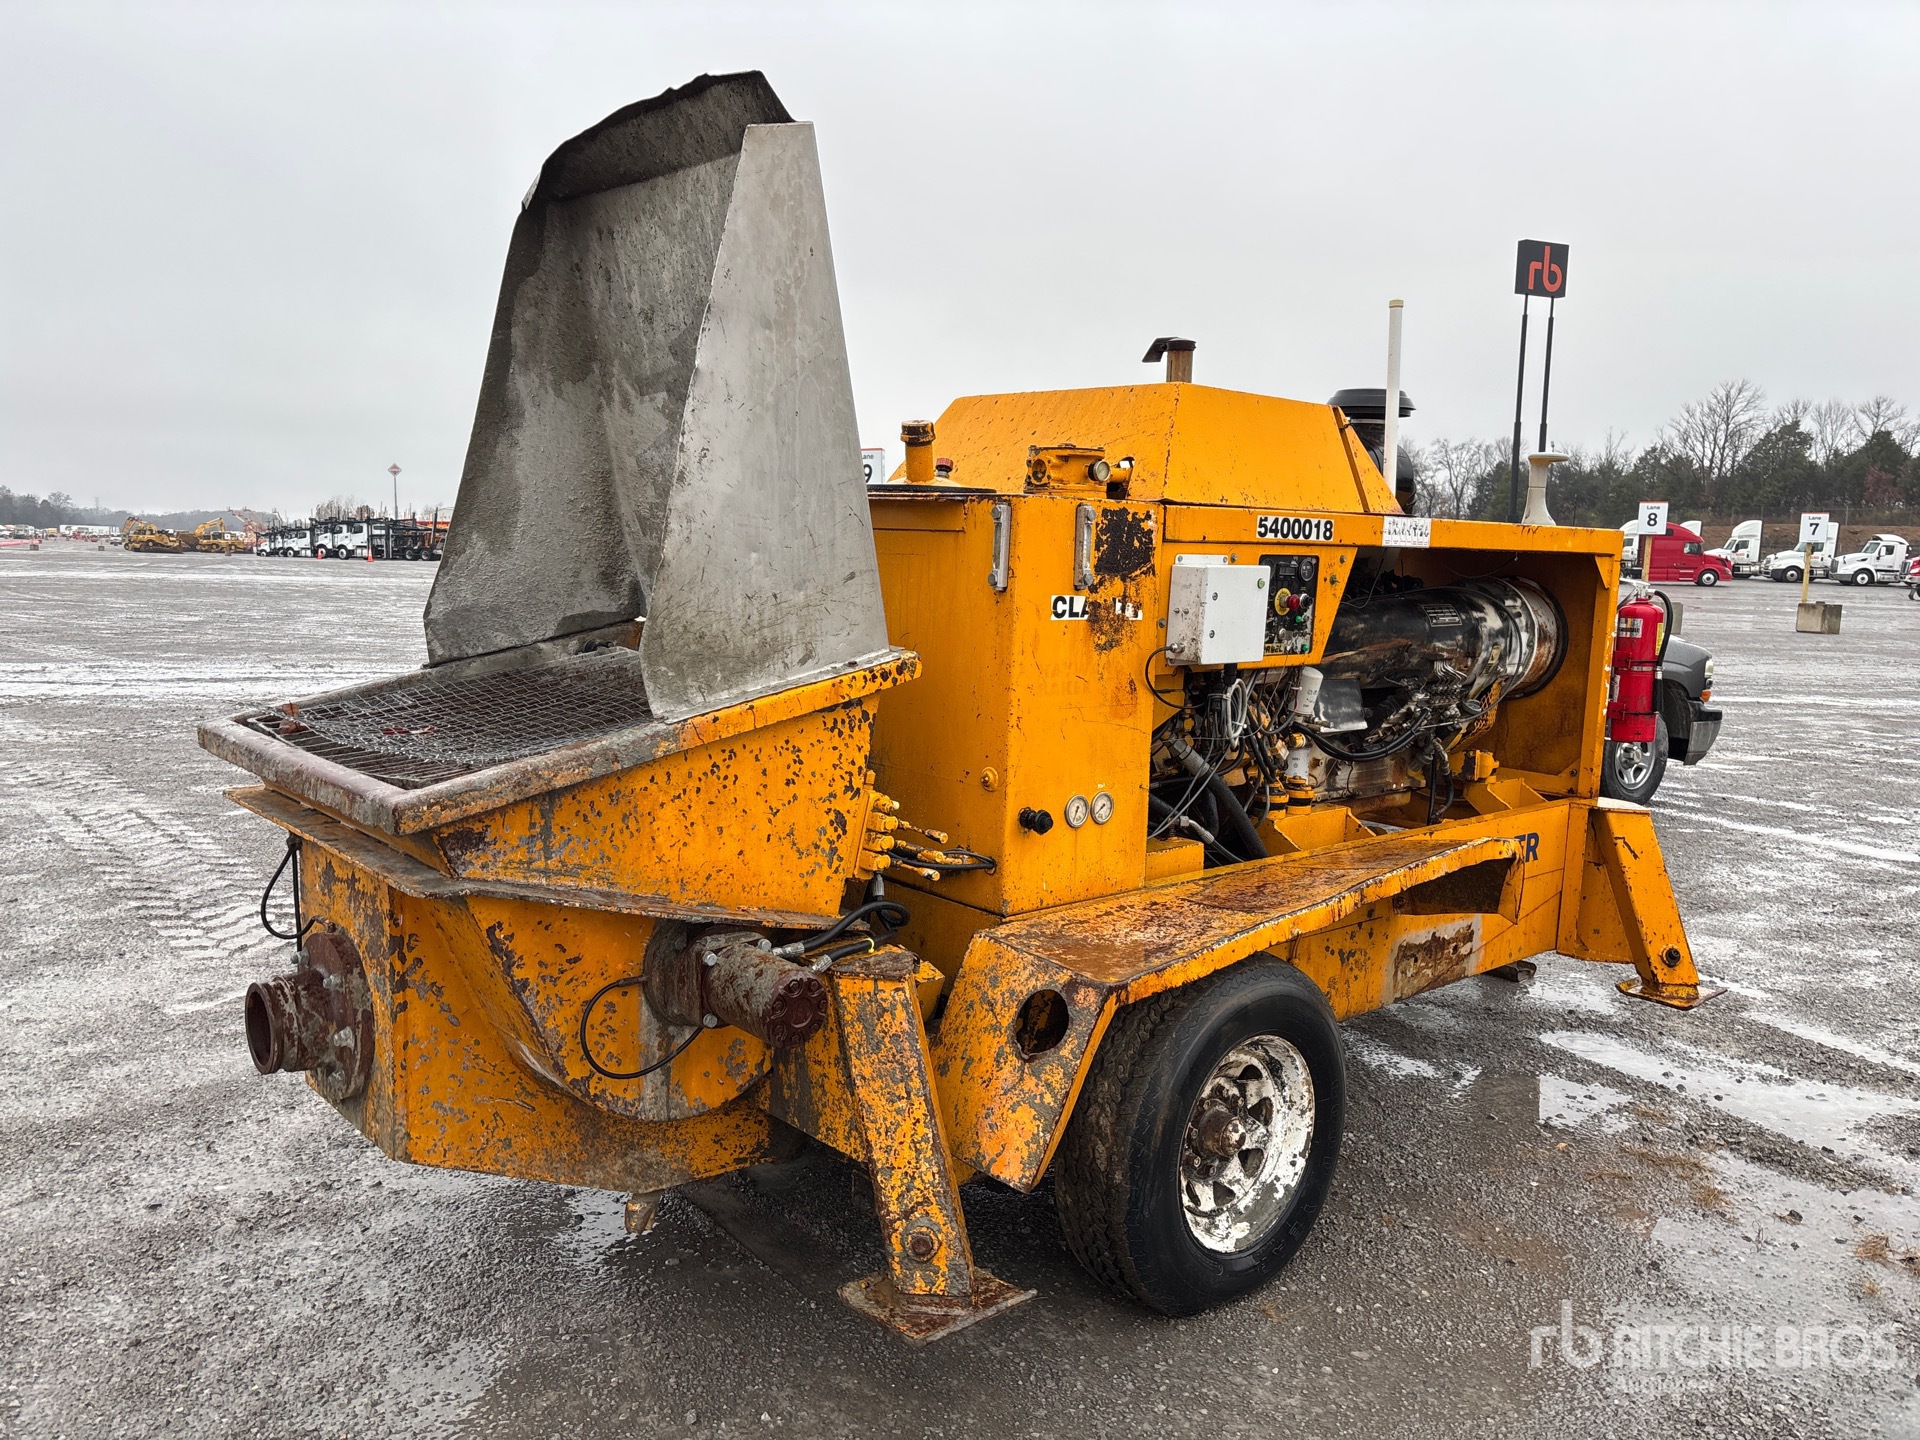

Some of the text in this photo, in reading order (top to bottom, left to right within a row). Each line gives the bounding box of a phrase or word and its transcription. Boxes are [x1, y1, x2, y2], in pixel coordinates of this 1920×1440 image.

[1527, 245, 1563, 293] rb
[863, 463, 873, 484] 9
[1257, 516, 1334, 541] 5400018
[1646, 512, 1658, 527] 8
[1809, 522, 1820, 536] 7
